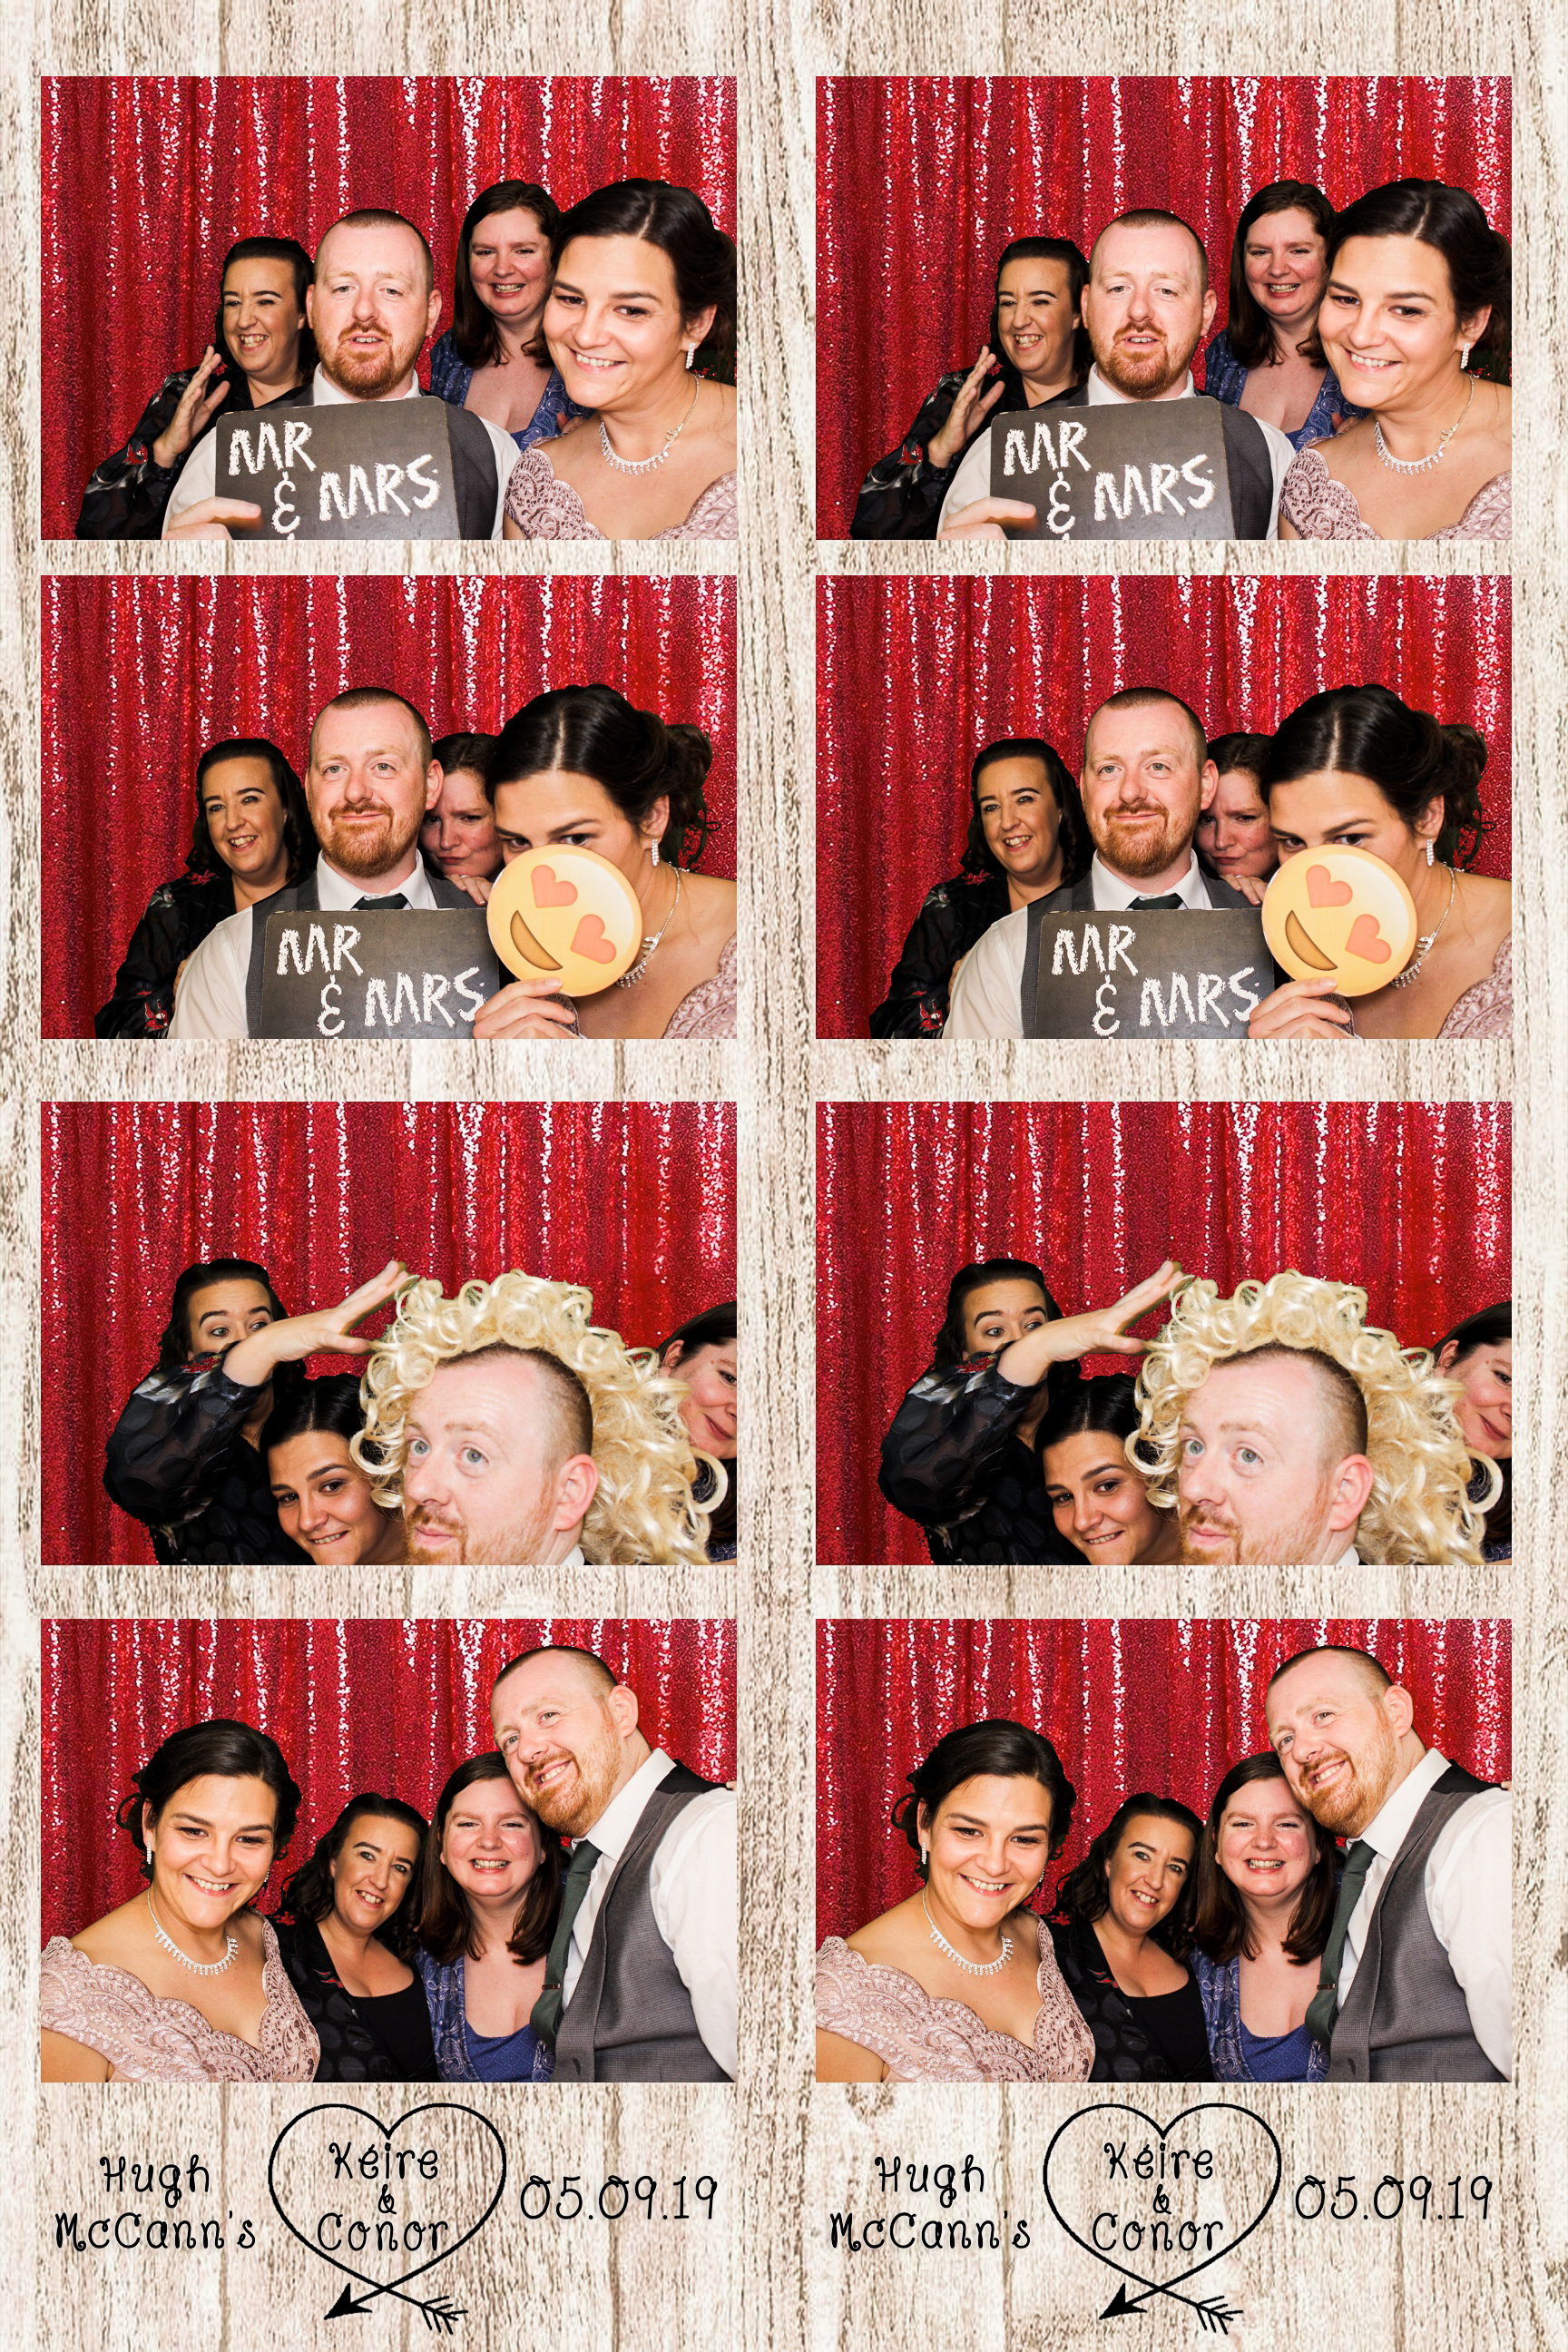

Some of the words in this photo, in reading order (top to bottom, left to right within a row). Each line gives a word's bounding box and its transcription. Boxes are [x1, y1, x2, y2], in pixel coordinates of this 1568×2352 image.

[229, 420, 317, 475] MR
[1004, 420, 1092, 475] MR
[271, 471, 301, 539] &
[318, 454, 443, 521] MRS
[1046, 471, 1076, 539] &
[1093, 454, 1218, 521] MRS
[276, 923, 364, 976] MR
[1051, 923, 1139, 976] MR
[317, 975, 346, 1038] &
[364, 966, 488, 1028] MRS
[1092, 975, 1121, 1038] &
[1139, 966, 1263, 1028] MRS
